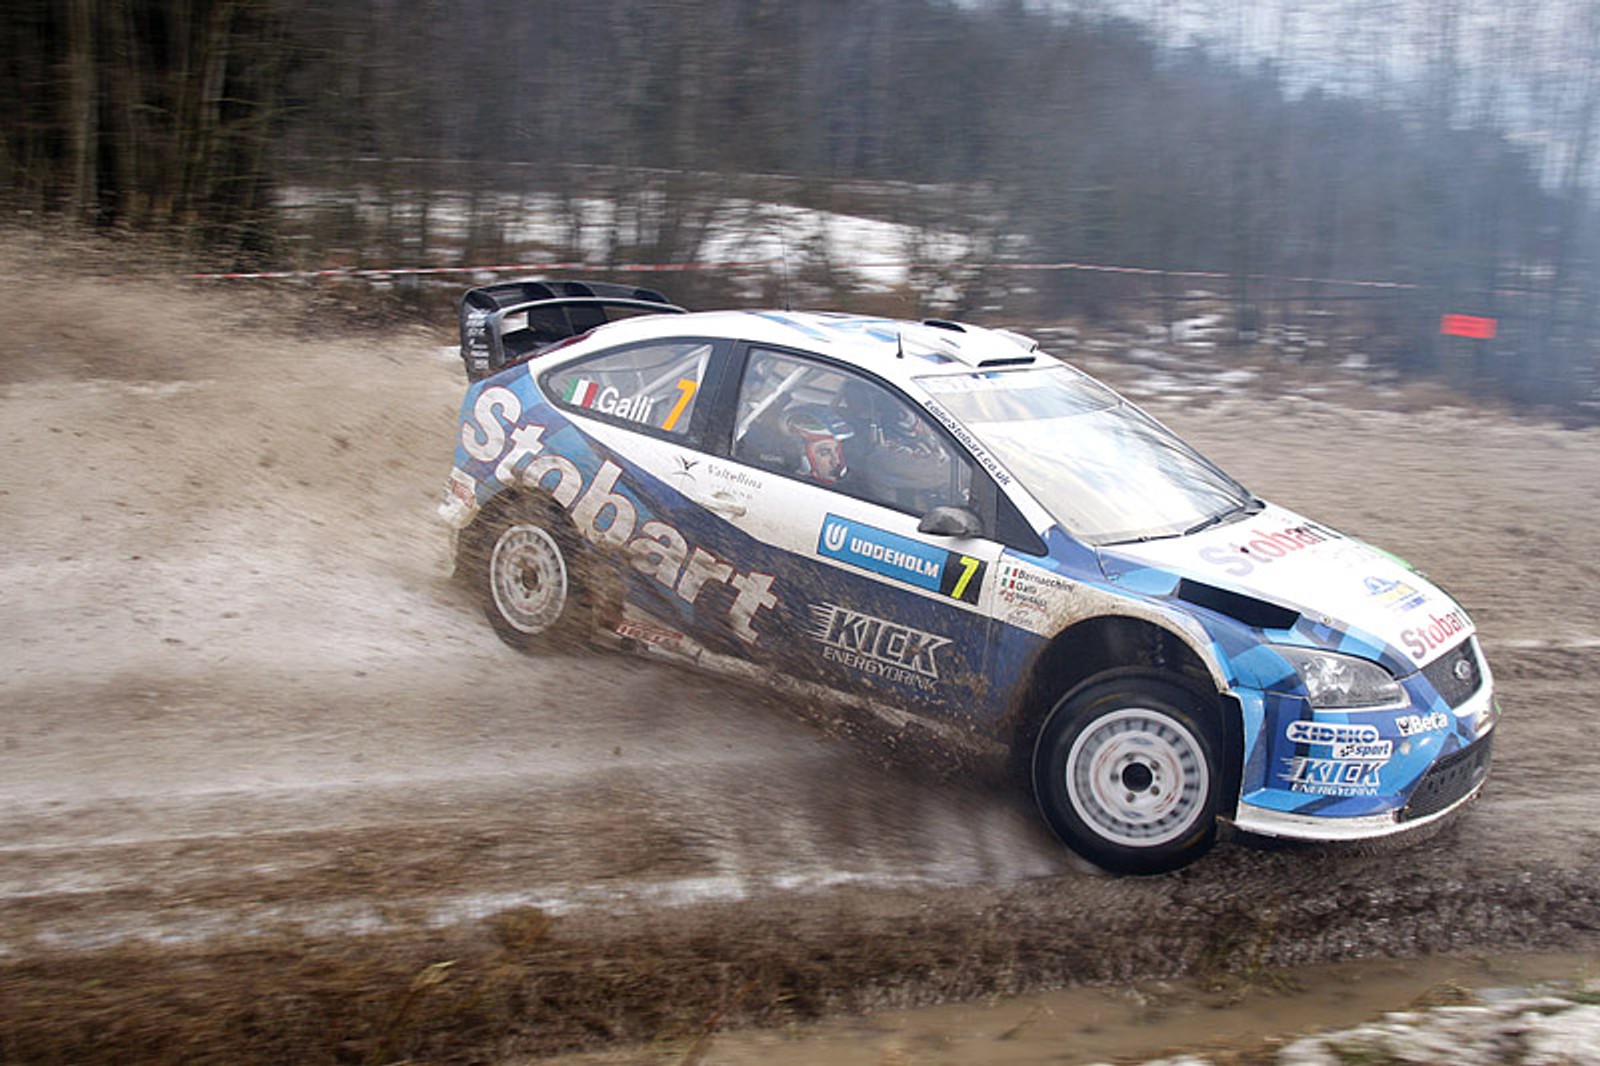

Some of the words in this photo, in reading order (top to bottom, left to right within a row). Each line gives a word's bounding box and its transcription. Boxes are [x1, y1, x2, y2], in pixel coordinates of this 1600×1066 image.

[598, 386, 655, 423] Galli
[662, 378, 698, 431] 7
[461, 385, 780, 645] Stobart
[851, 537, 940, 578] UDDEHOLM
[951, 555, 980, 599] 7
[808, 602, 953, 679] KICK
[1411, 712, 1449, 733] Beta
[1280, 757, 1389, 786] KICK
[1355, 743, 1390, 759] sport
